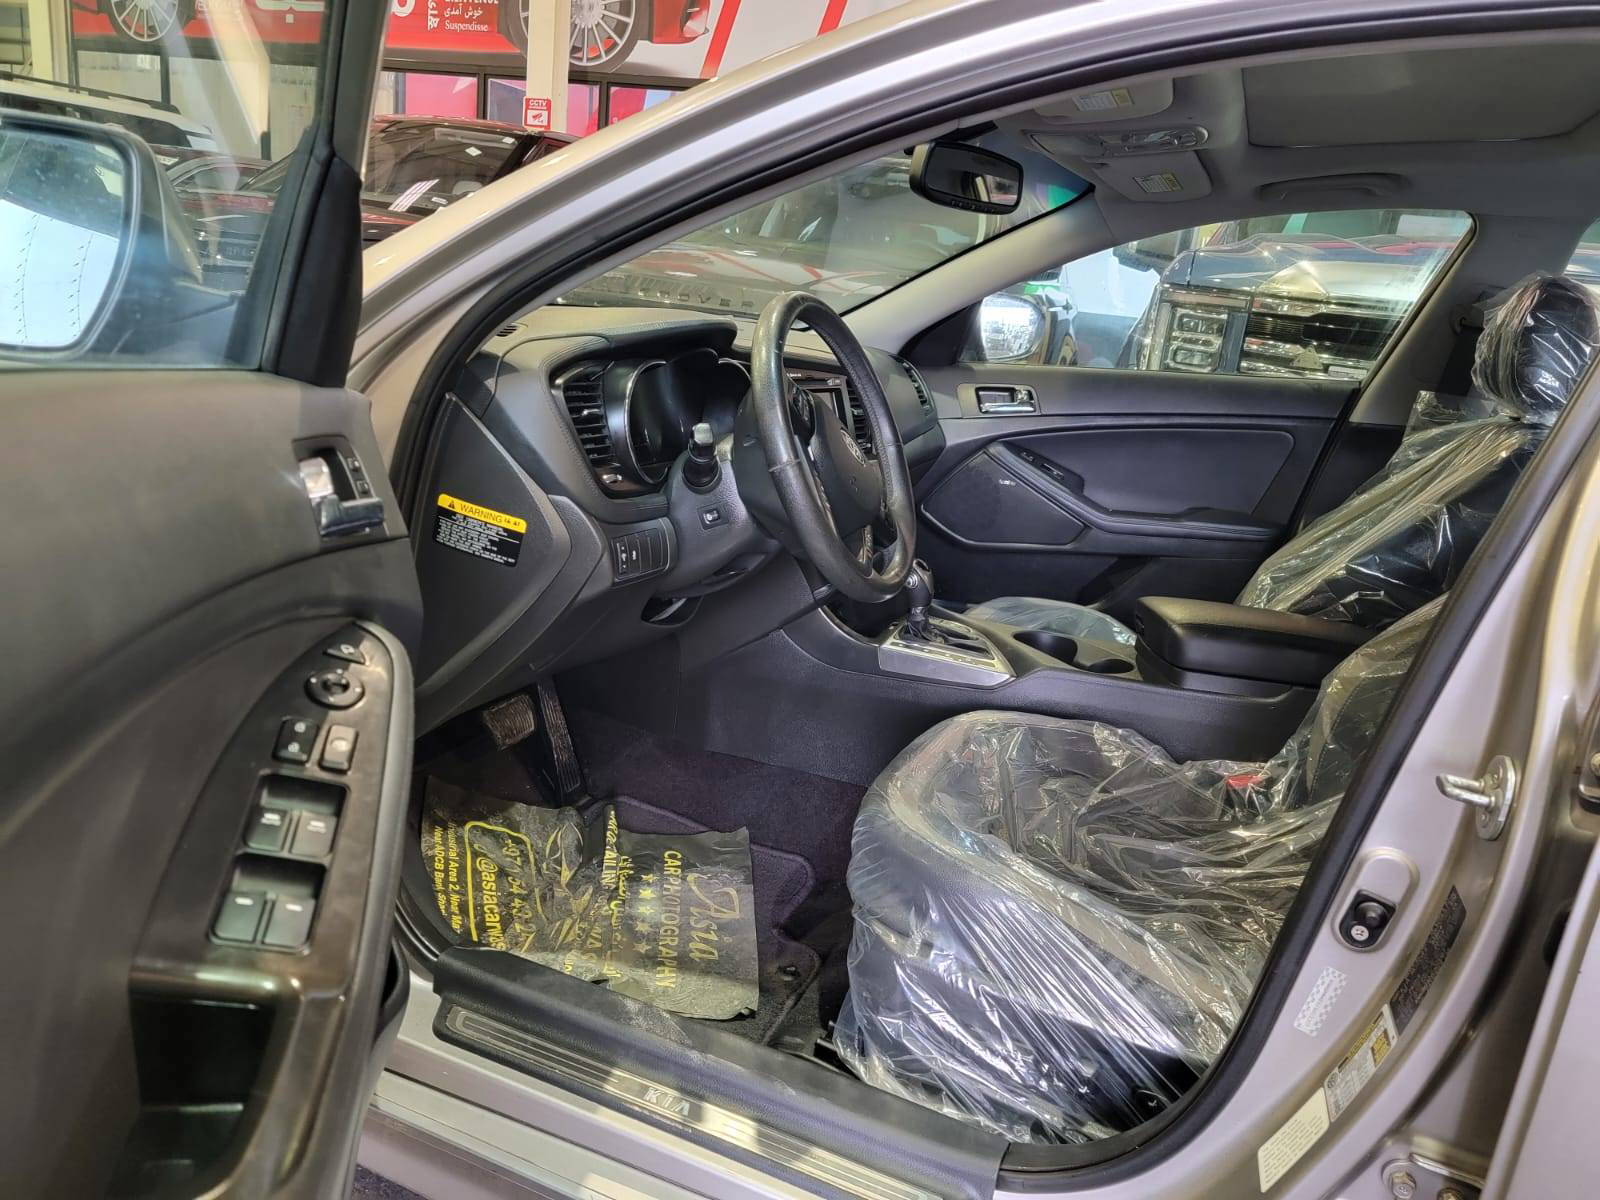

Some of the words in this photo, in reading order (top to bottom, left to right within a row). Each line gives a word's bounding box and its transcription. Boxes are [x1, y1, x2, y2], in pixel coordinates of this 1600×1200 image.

[445, 20, 489, 32] Suspendisse
[529, 99, 548, 107] CCTV
[460, 503, 503, 523] WARNING
[448, 860, 460, 882] Area
[687, 873, 740, 961] Asia
[643, 1086, 690, 1116] KIA
